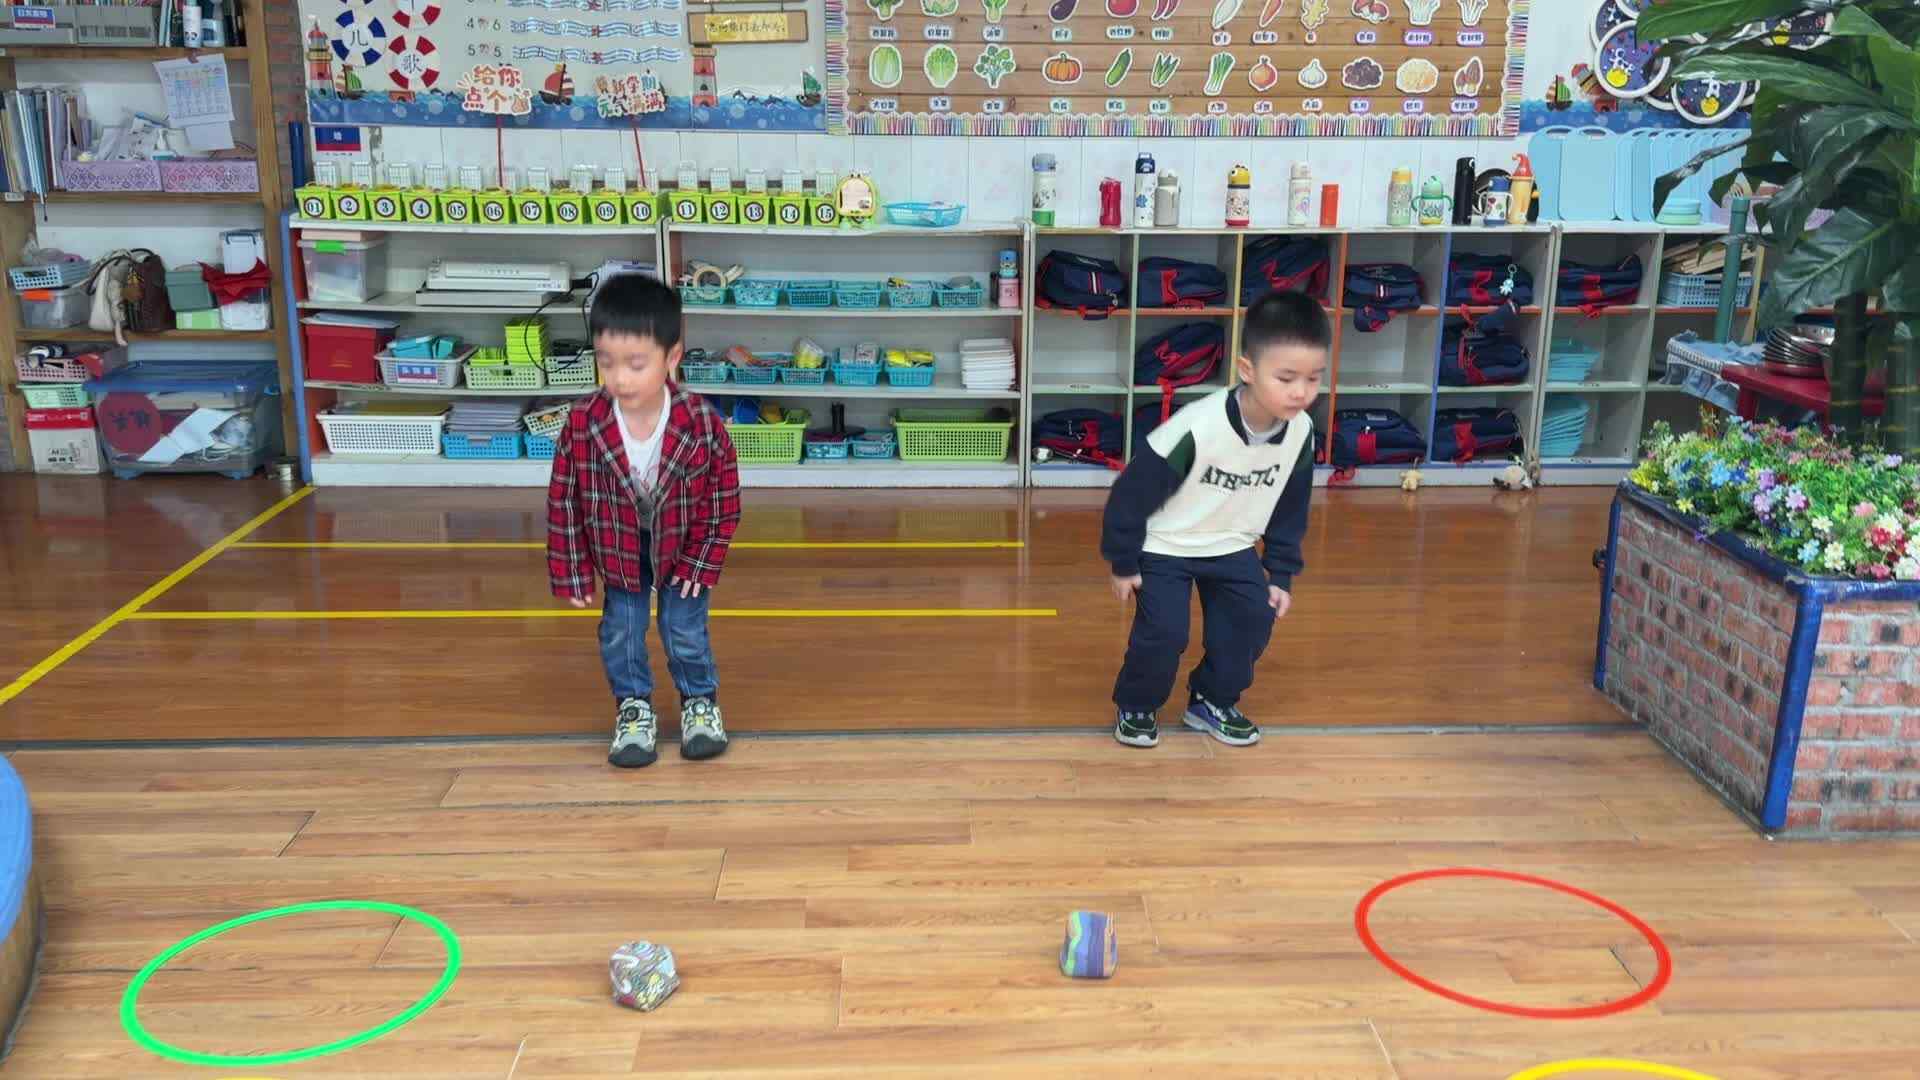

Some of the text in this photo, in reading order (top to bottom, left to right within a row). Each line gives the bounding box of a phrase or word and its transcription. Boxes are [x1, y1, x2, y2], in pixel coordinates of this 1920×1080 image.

[467, 18, 475, 30] 4
[493, 19, 502, 31] 6
[350, 29, 369, 46] 儿
[468, 45, 476, 56] 5
[494, 46, 502, 58] 5
[402, 53, 423, 73] 歌
[473, 65, 522, 89] 给你
[307, 202, 321, 213] 01
[449, 205, 464, 216] 05
[486, 205, 501, 216] 06
[523, 205, 538, 216] 07
[561, 205, 575, 216] 08
[599, 205, 613, 217] 09
[634, 205, 648, 217] 10
[680, 204, 693, 216] 11
[713, 205, 727, 216] 12
[747, 206, 762, 217] 13
[783, 207, 797, 220] 14
[818, 207, 832, 220] 15
